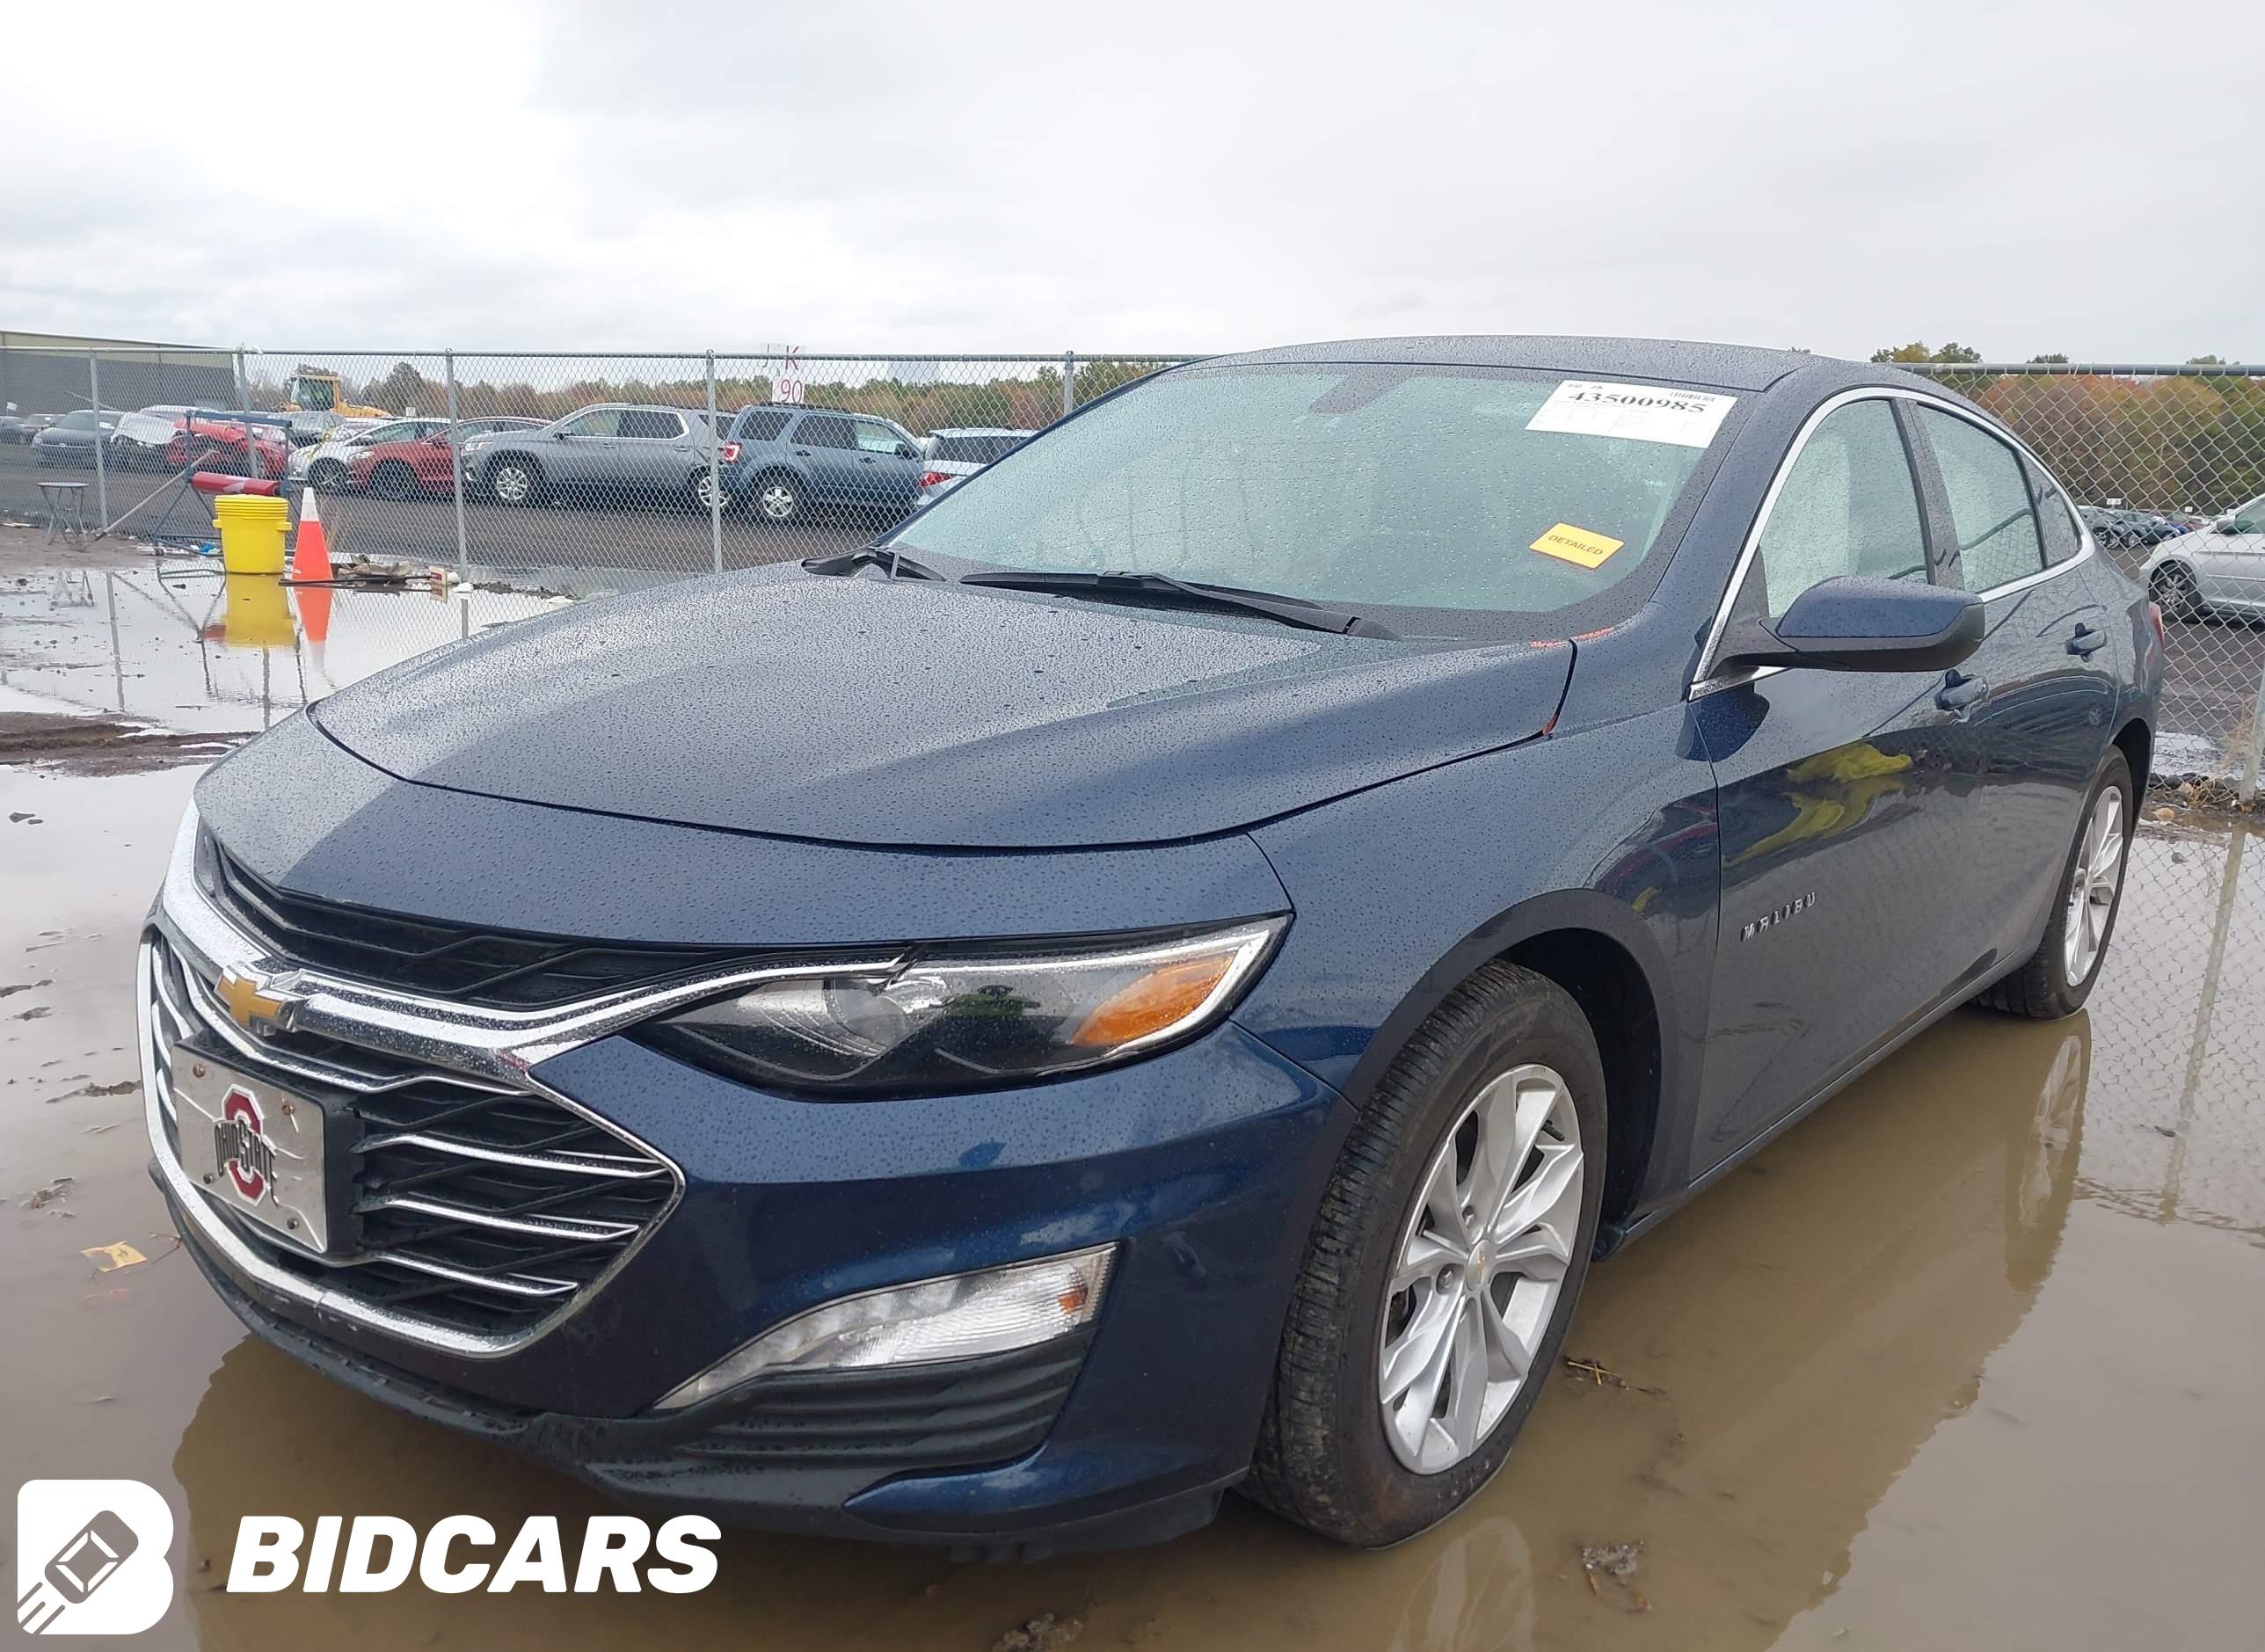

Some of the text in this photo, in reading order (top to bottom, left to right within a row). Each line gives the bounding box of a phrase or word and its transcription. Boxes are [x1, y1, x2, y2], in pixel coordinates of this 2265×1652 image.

[784, 345, 800, 371] K
[780, 379, 803, 404] 90
[1569, 391, 1708, 413] 43500985
[1548, 535, 1604, 556] DETAILED
[1741, 891, 1816, 942] MALIBU
